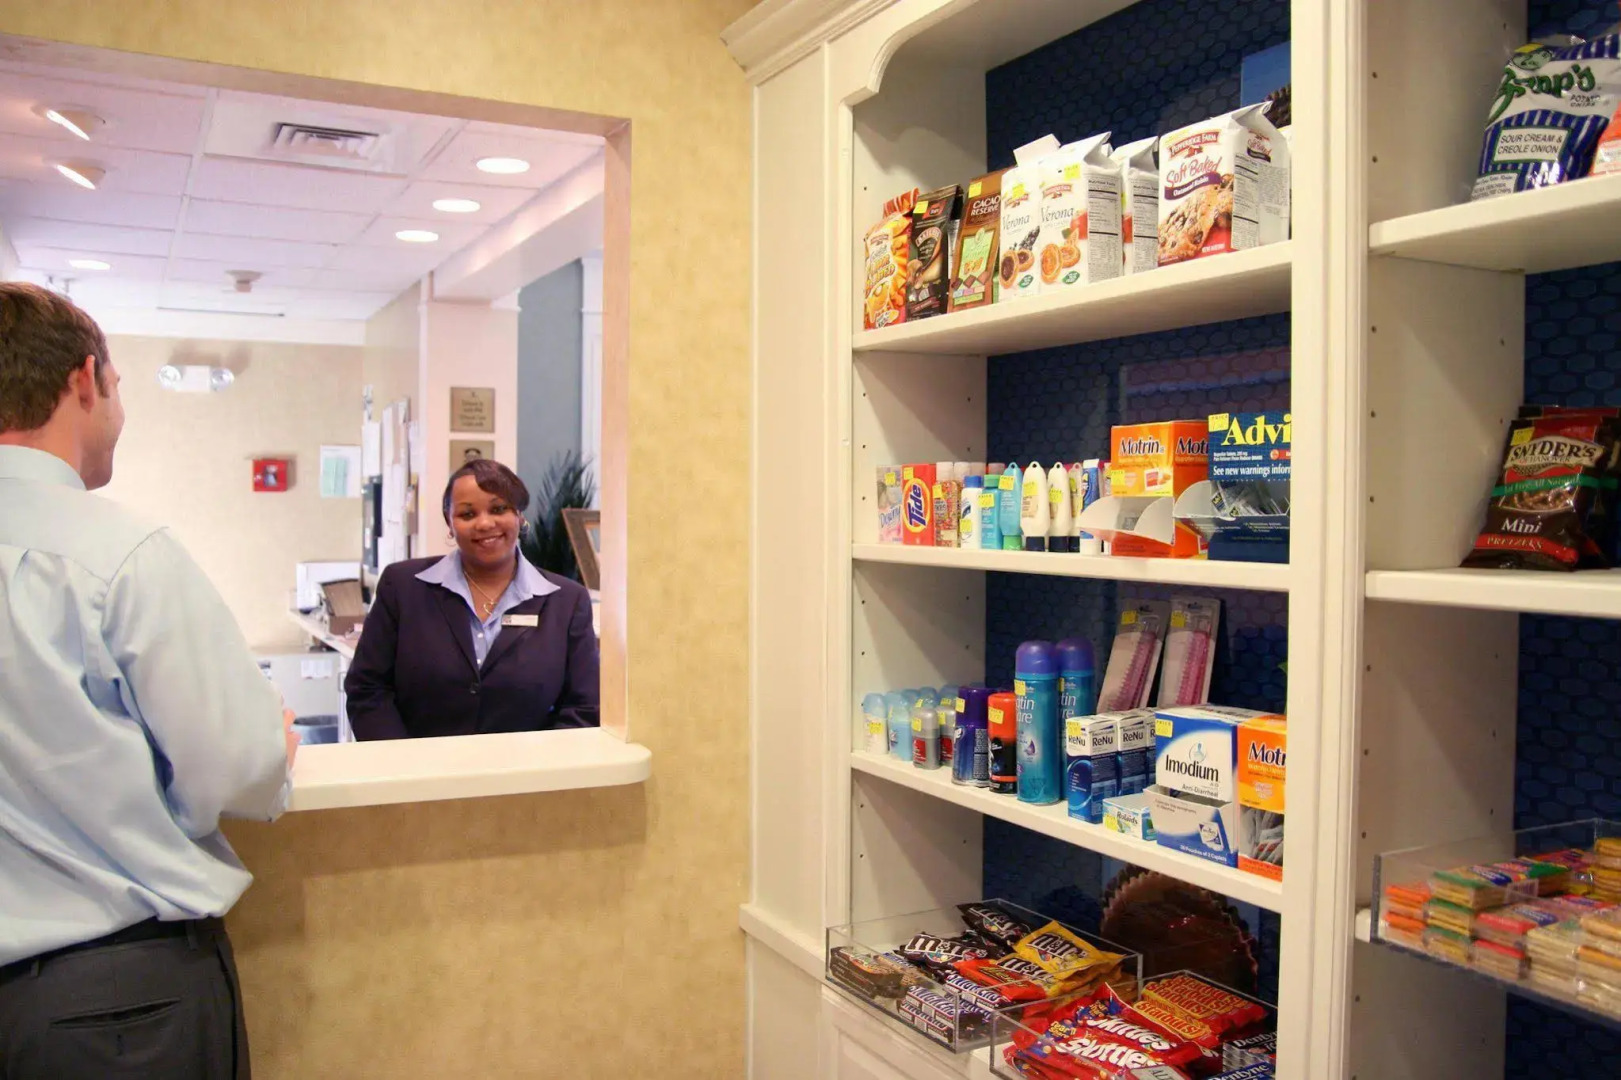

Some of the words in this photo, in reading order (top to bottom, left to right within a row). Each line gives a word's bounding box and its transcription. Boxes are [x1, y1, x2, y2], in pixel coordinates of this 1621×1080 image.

[1500, 134, 1522, 144] SOUR
[1524, 134, 1553, 143] CREAM
[1554, 135, 1563, 143] &
[1497, 145, 1528, 154] CREOLE
[1530, 144, 1559, 154] ONION
[1167, 164, 1187, 188] Soft
[1190, 156, 1222, 177] Baked
[973, 195, 1000, 209] CACAO
[1002, 213, 1030, 231] Verona
[1040, 206, 1075, 224] Verona
[1119, 435, 1160, 455] Motrin
[1511, 440, 1595, 461] SNYDER'S
[1213, 465, 1224, 476] See
[1225, 467, 1239, 476] new
[1239, 464, 1270, 478] warnings
[907, 484, 927, 526] Tide
[1501, 517, 1543, 533] Mini
[1487, 536, 1544, 549] PRETZELS
[1092, 735, 1114, 747] ReNu
[1123, 732, 1144, 743] ReNu
[1165, 754, 1219, 782] Imodium
[1182, 783, 1219, 798] Anti-Diarrheal
